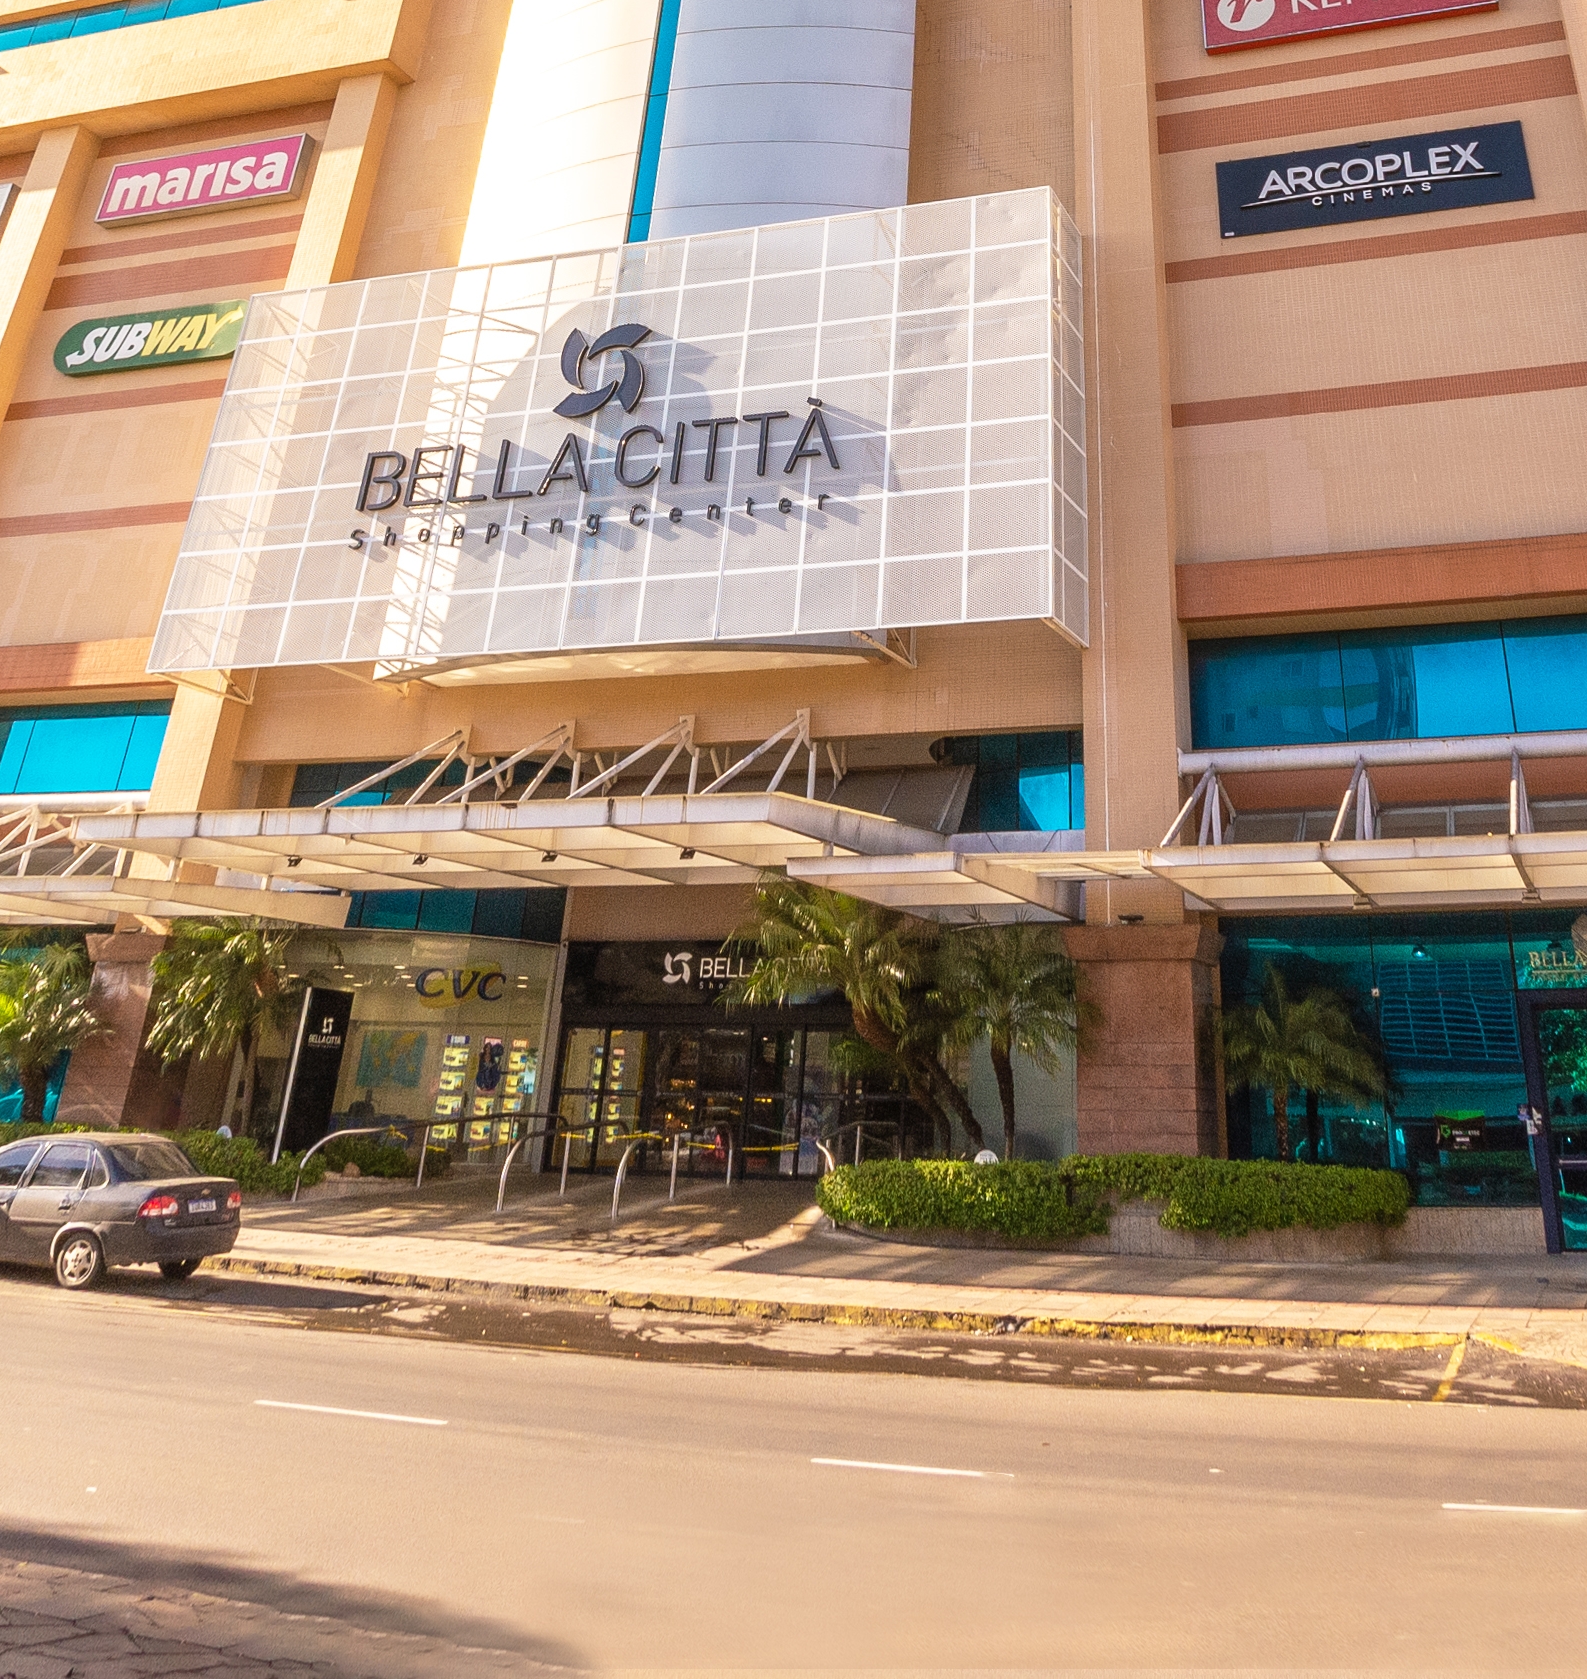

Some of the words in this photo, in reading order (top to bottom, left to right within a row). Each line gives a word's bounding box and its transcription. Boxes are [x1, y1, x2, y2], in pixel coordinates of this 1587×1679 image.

[105, 151, 289, 213] marisa
[1258, 141, 1485, 199] ARCOPLEX
[1311, 181, 1433, 207] CINEMAS
[64, 305, 245, 368] SUBWAY
[355, 432, 589, 512] BELLA
[614, 397, 840, 488] CITTÀ
[348, 511, 602, 551] Shopping
[628, 492, 831, 527] Center
[415, 967, 507, 1002] CVC
[699, 956, 764, 979] BELLA
